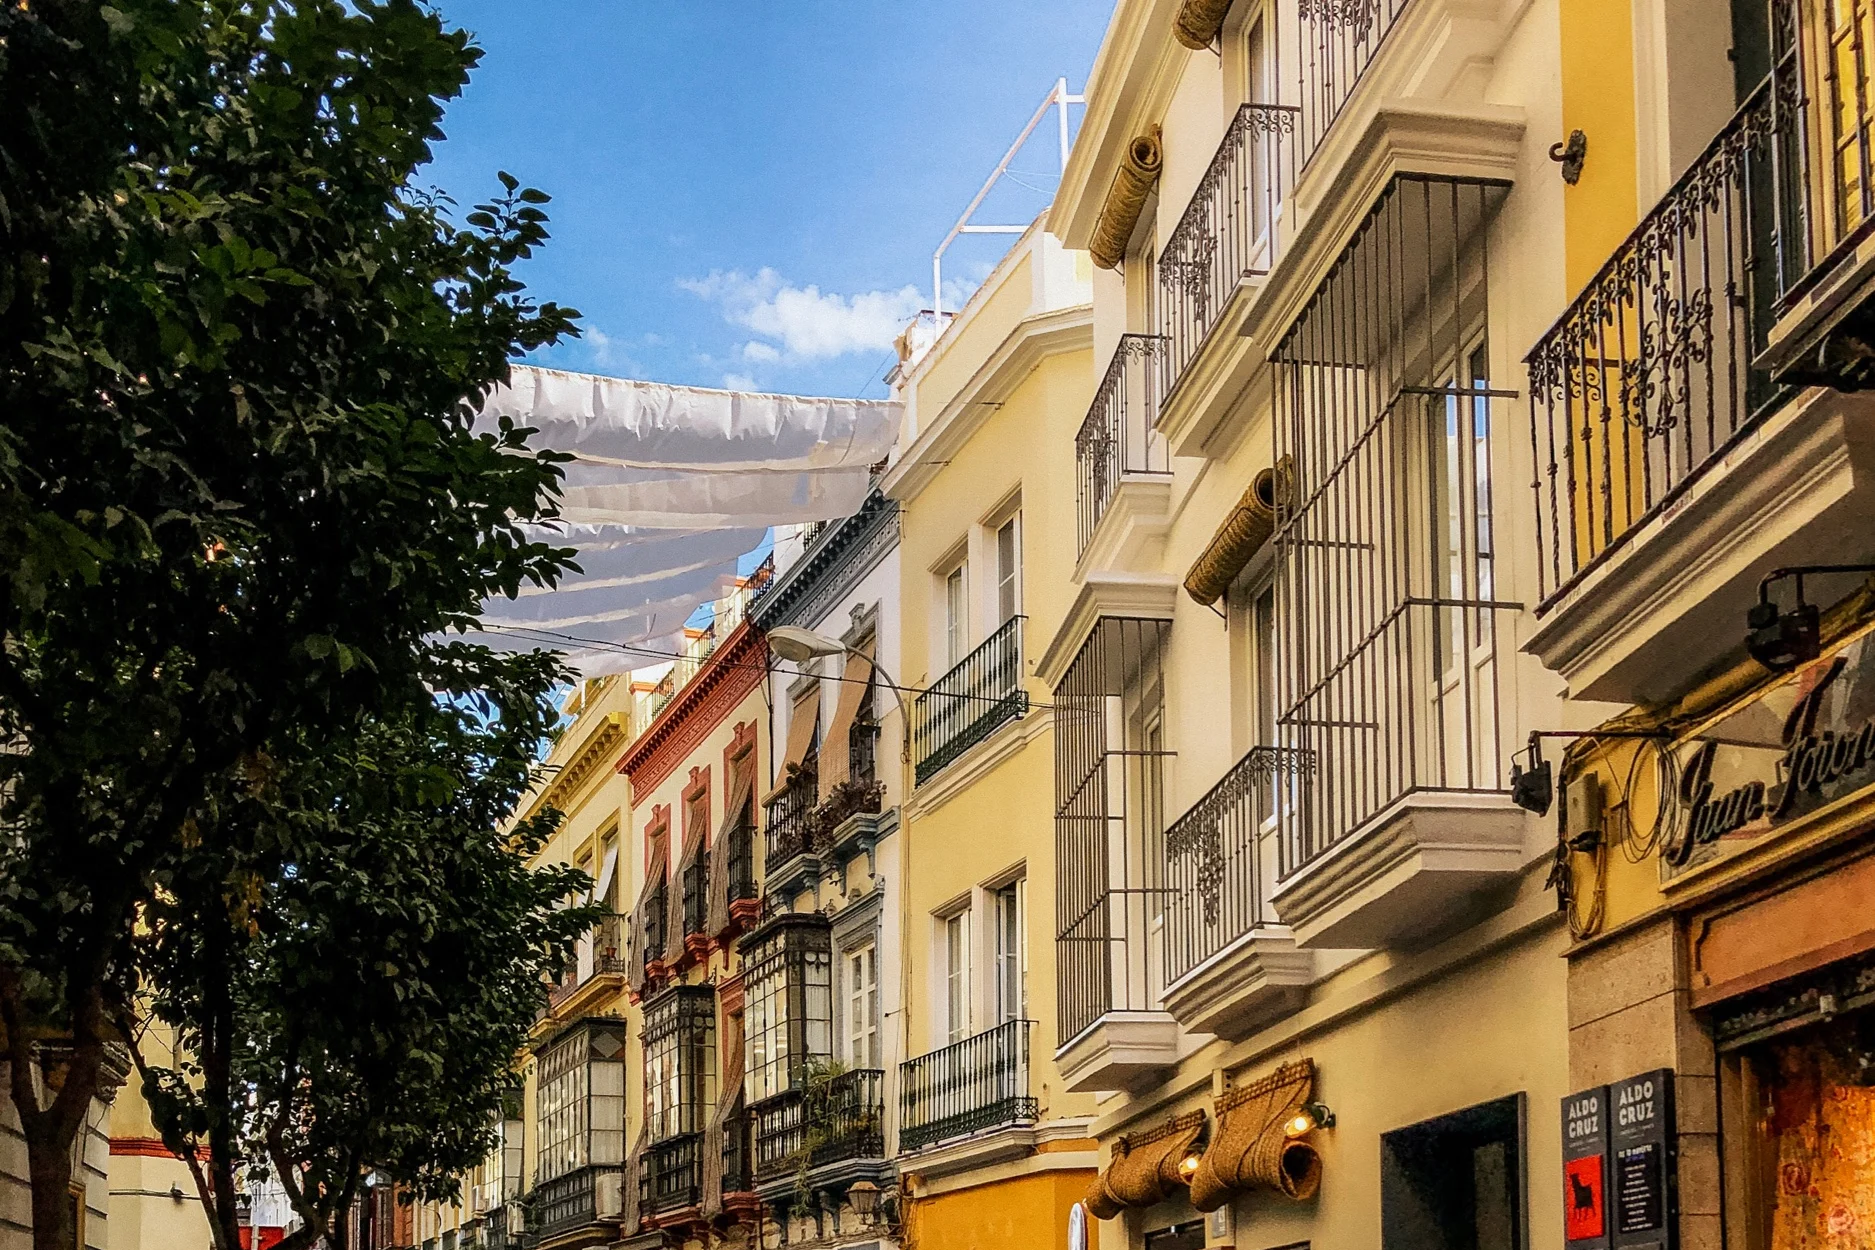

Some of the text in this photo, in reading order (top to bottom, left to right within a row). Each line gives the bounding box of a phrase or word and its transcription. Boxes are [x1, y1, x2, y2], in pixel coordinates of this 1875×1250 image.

[1665, 739, 1765, 866] Juan
[1618, 1080, 1654, 1106] ALDO
[1568, 1096, 1598, 1120] ALDO
[1619, 1100, 1655, 1126] CRUZ
[1568, 1115, 1599, 1138] CRUZ
